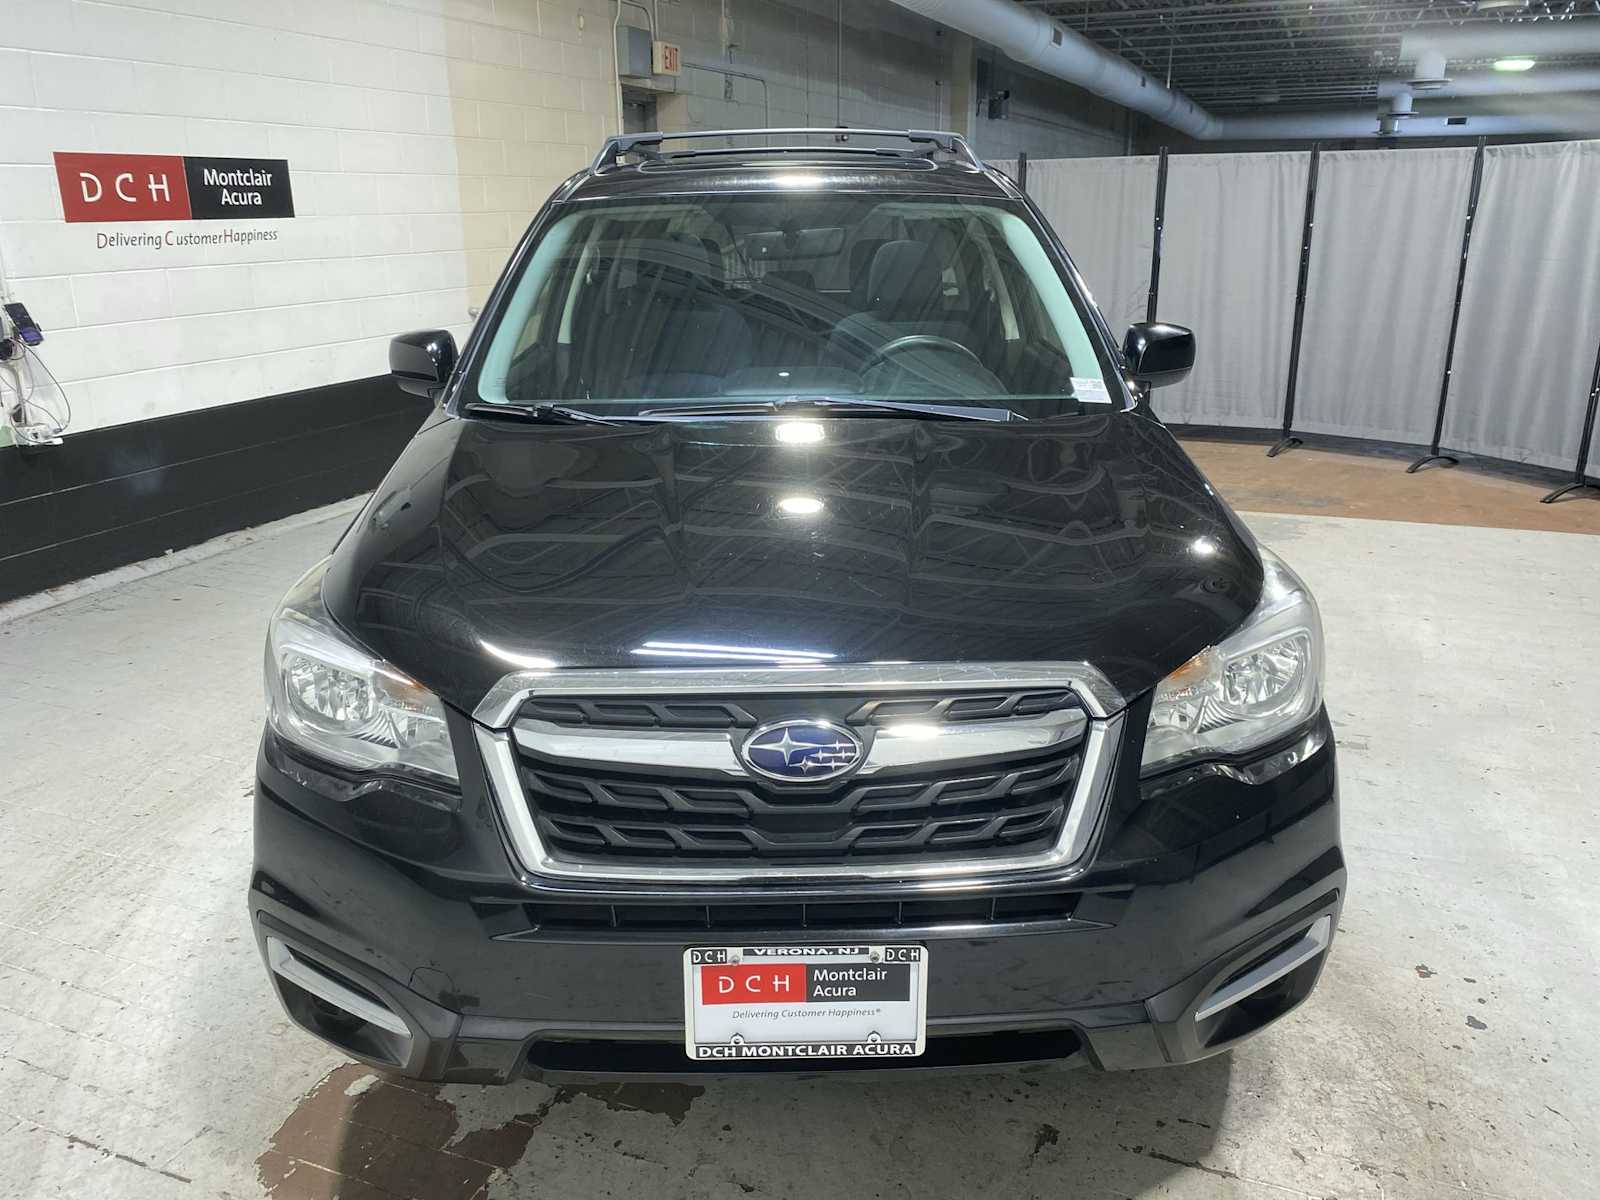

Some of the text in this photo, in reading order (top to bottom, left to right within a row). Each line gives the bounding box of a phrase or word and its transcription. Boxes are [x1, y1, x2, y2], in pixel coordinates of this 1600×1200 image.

[203, 168, 273, 187] Montclair
[79, 171, 171, 203] DCH
[221, 189, 262, 206] Acura
[96, 232, 162, 250] Delivering
[692, 950, 727, 963] DCH
[886, 948, 920, 961] DCH
[813, 968, 887, 982] Montclair
[718, 975, 791, 994] DCH
[813, 984, 857, 997] Acura
[732, 1010, 779, 1019] Delivering
[781, 1009, 826, 1018] Customer
[699, 1043, 913, 1057] DCH MONTCLAIR ACURA
